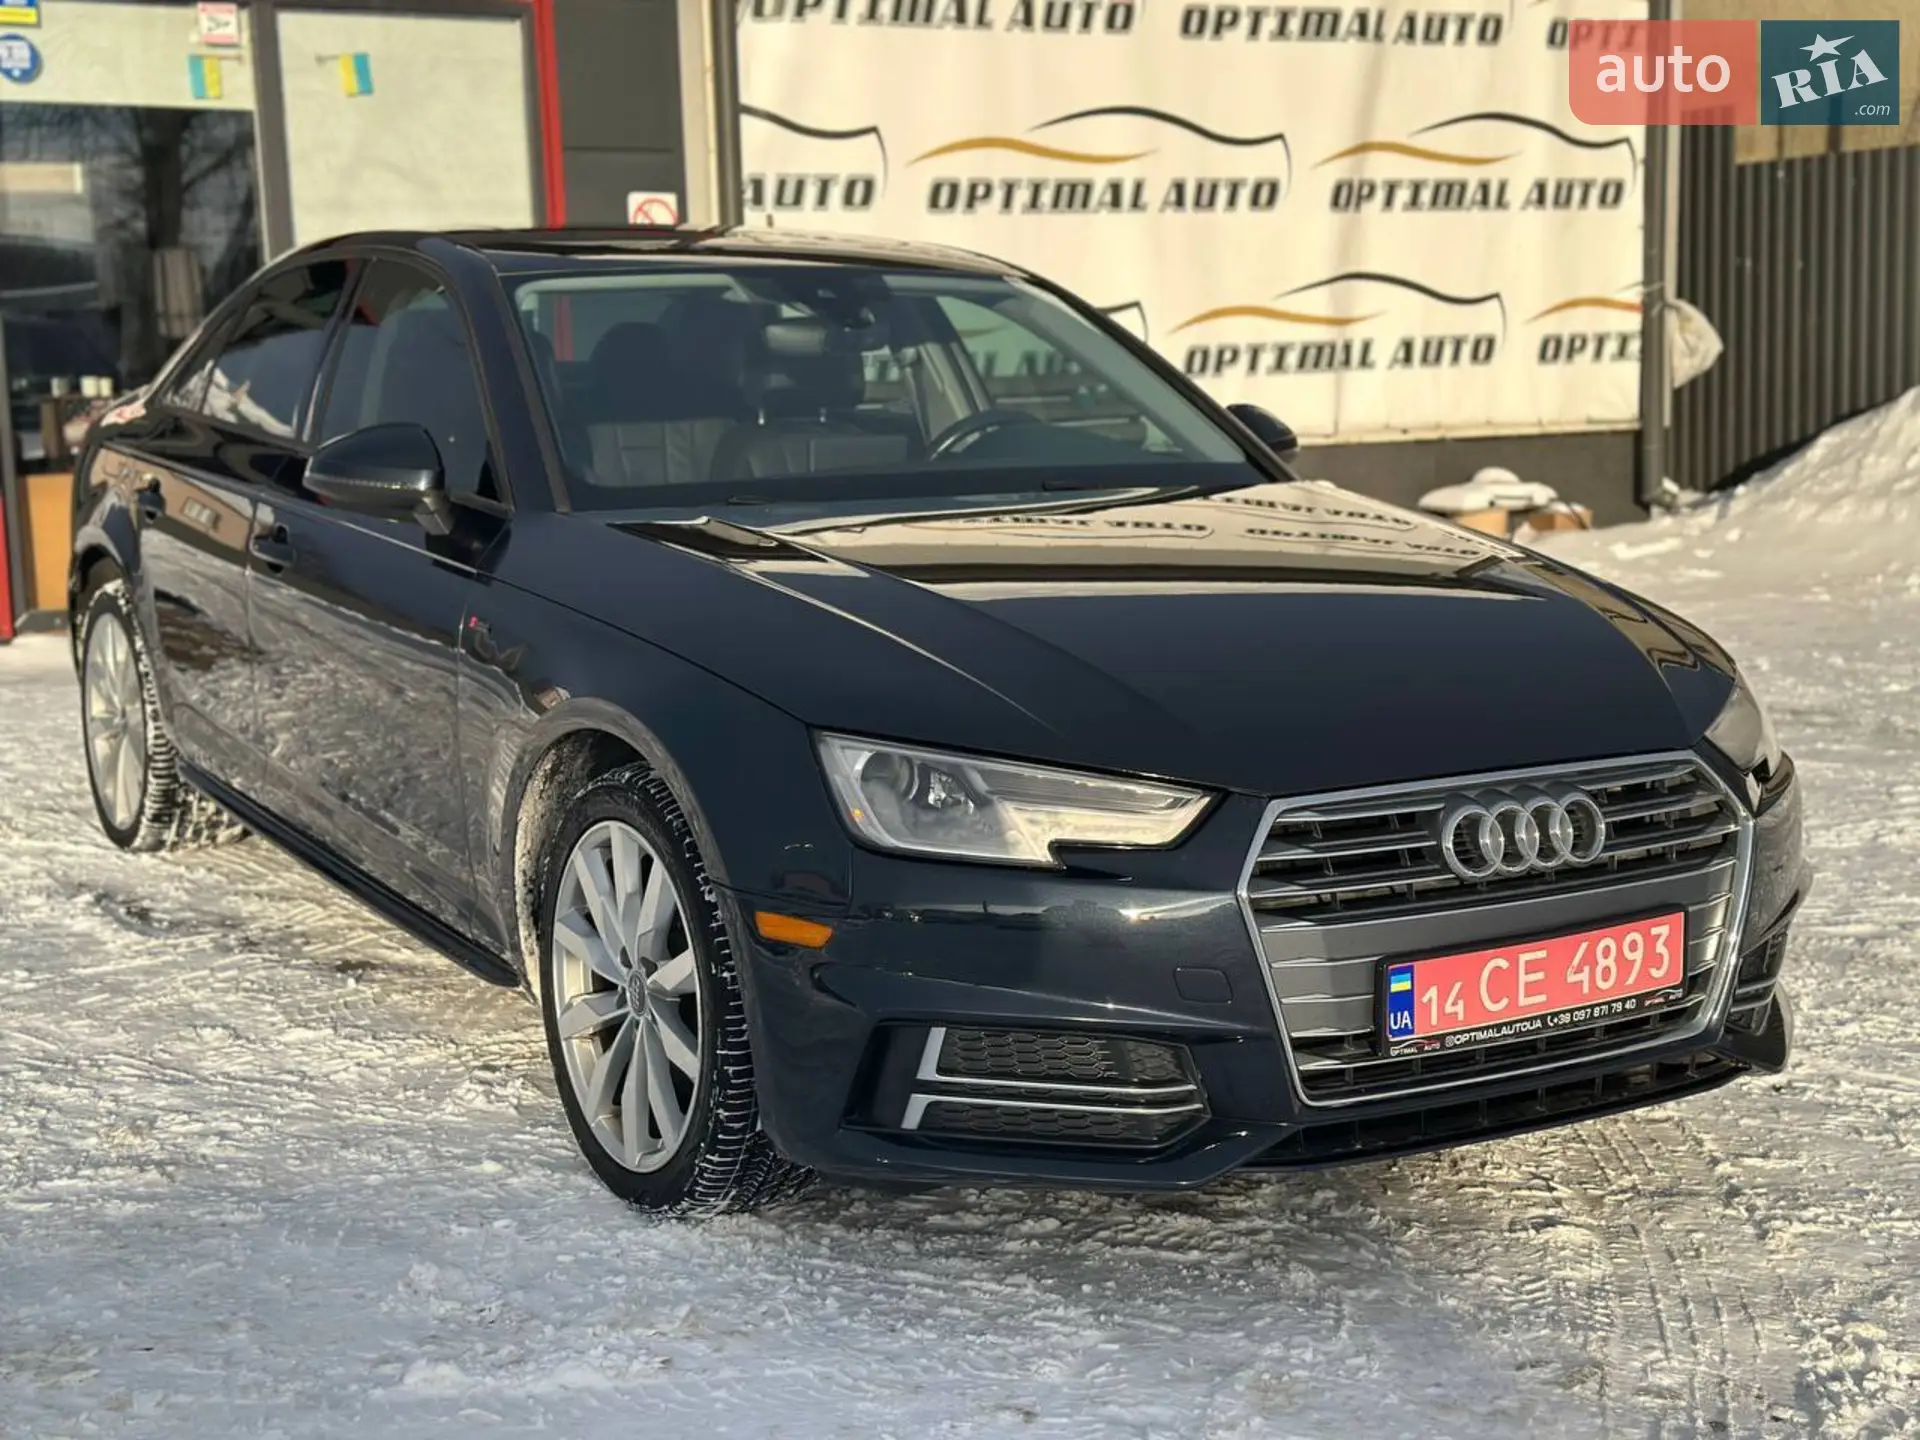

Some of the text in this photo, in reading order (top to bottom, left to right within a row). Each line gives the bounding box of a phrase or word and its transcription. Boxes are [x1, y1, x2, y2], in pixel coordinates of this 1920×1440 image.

[749, 0, 1135, 35] OPTIMAL AUTO
[1179, 3, 1503, 47] OPTIMAL AUTO
[741, 173, 876, 211] AUTO
[926, 176, 1282, 214] OPTIMAL AUTO
[1329, 177, 1626, 212] OPTIMAL AUTO
[1183, 333, 1497, 379] OPTIMAL AUTO
[1421, 923, 1671, 1026] 14 CE 4893
[1390, 1011, 1413, 1030] UA
[1572, 1009, 1591, 1022] 097
[1611, 1001, 1623, 1014] 79
[1624, 998, 1637, 1010] 40
